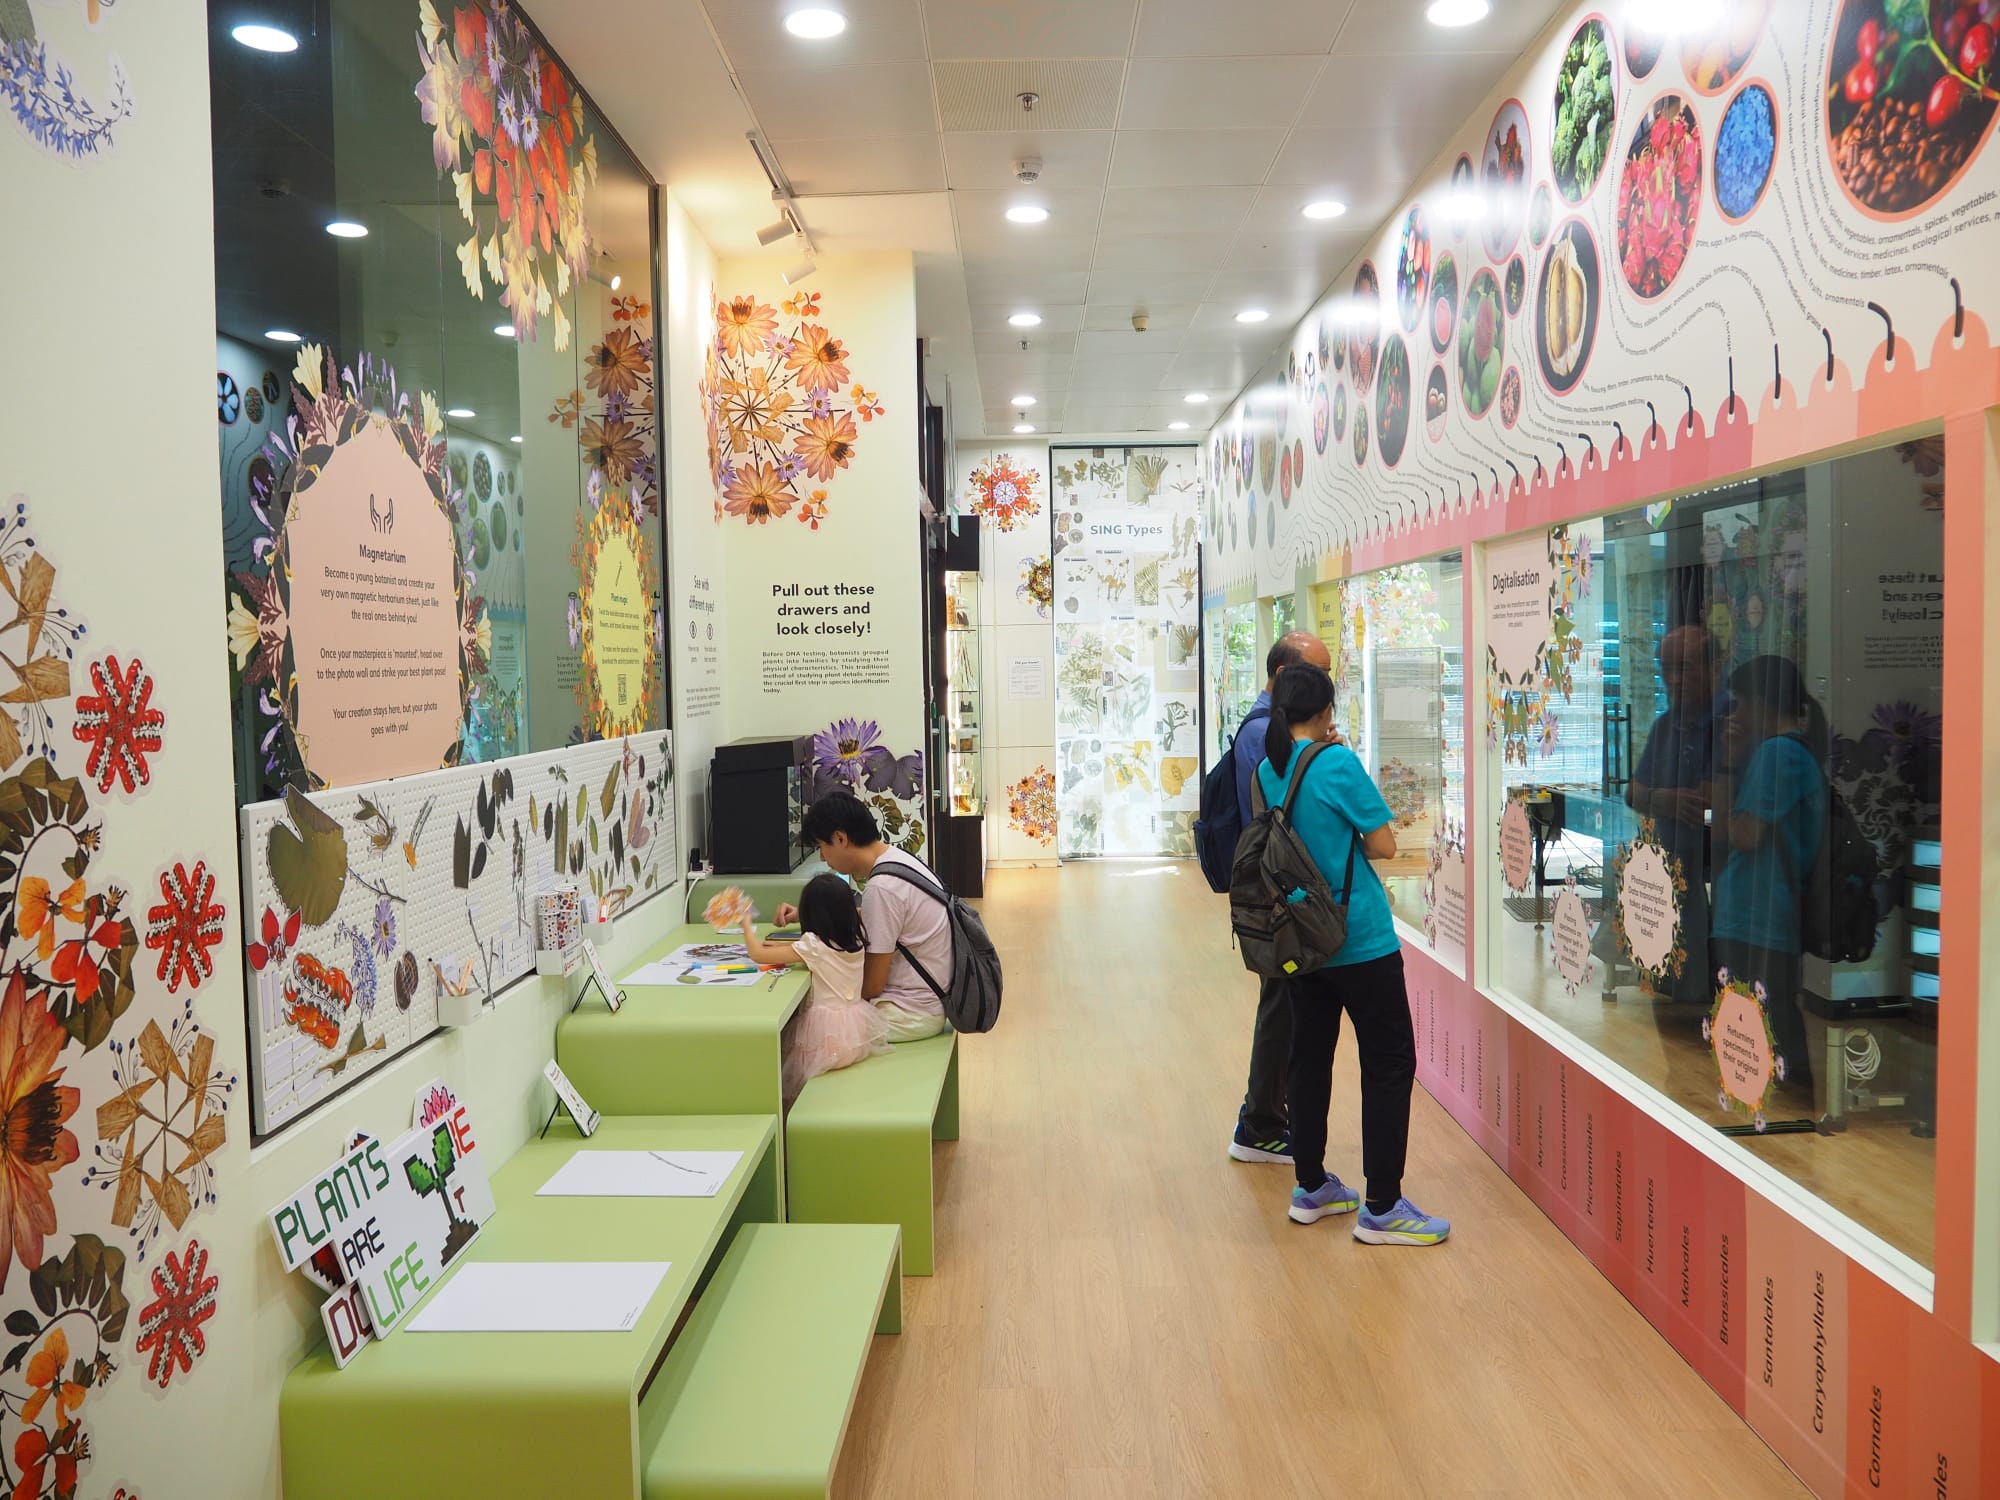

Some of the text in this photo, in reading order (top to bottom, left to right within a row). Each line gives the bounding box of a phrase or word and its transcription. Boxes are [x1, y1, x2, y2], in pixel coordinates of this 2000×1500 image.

[1924, 213, 1950, 231] spices,
[1951, 189, 1998, 218] vegetables,
[1911, 226, 1952, 251] ecological
[1954, 211, 1993, 233] services,
[1905, 262, 1949, 279] ornamentals
[1090, 524, 1163, 537] SING Types
[359, 543, 407, 565] Magnetarium
[324, 565, 349, 580] Become
[350, 572, 355, 580] a
[355, 573, 374, 585] young
[1492, 568, 1540, 594] Digitalisation
[320, 588, 335, 600] very
[335, 590, 349, 599] own
[350, 591, 377, 604] magnetic
[772, 582, 875, 597] Pull out these
[351, 608, 361, 620] the
[362, 609, 374, 621] real
[374, 612, 388, 621] ones
[777, 601, 870, 616] drawers and
[777, 621, 871, 637] look closely!
[320, 647, 337, 659] Once
[337, 650, 352, 661] your
[352, 649, 387, 661] masterpiece
[316, 669, 325, 679] to
[325, 668, 336, 679] the
[337, 667, 355, 681] photo
[355, 667, 369, 678] wall
[369, 667, 381, 678] and
[332, 708, 347, 719] Your
[348, 706, 372, 718] creation
[372, 706, 388, 718] stays
[370, 726, 384, 738] goes
[385, 722, 397, 734] with
[1727, 1024, 1755, 1048] Returning
[1722, 1037, 1760, 1062] specimens to
[1723, 1050, 1759, 1077] their original
[1735, 1069, 1746, 1083] box
[274, 1139, 390, 1265] PLANTS
[1646, 1176, 1654, 1275] Huerteales
[342, 1216, 385, 1277] ARE
[1681, 1224, 1689, 1309] Malvales
[367, 1240, 430, 1328] LIFE
[1719, 1233, 1729, 1346] Brassicales
[1763, 1276, 1774, 1389] Santalales
[1811, 1270, 1828, 1435] Caryophyllales
[1868, 1385, 1883, 1489] Cornales
